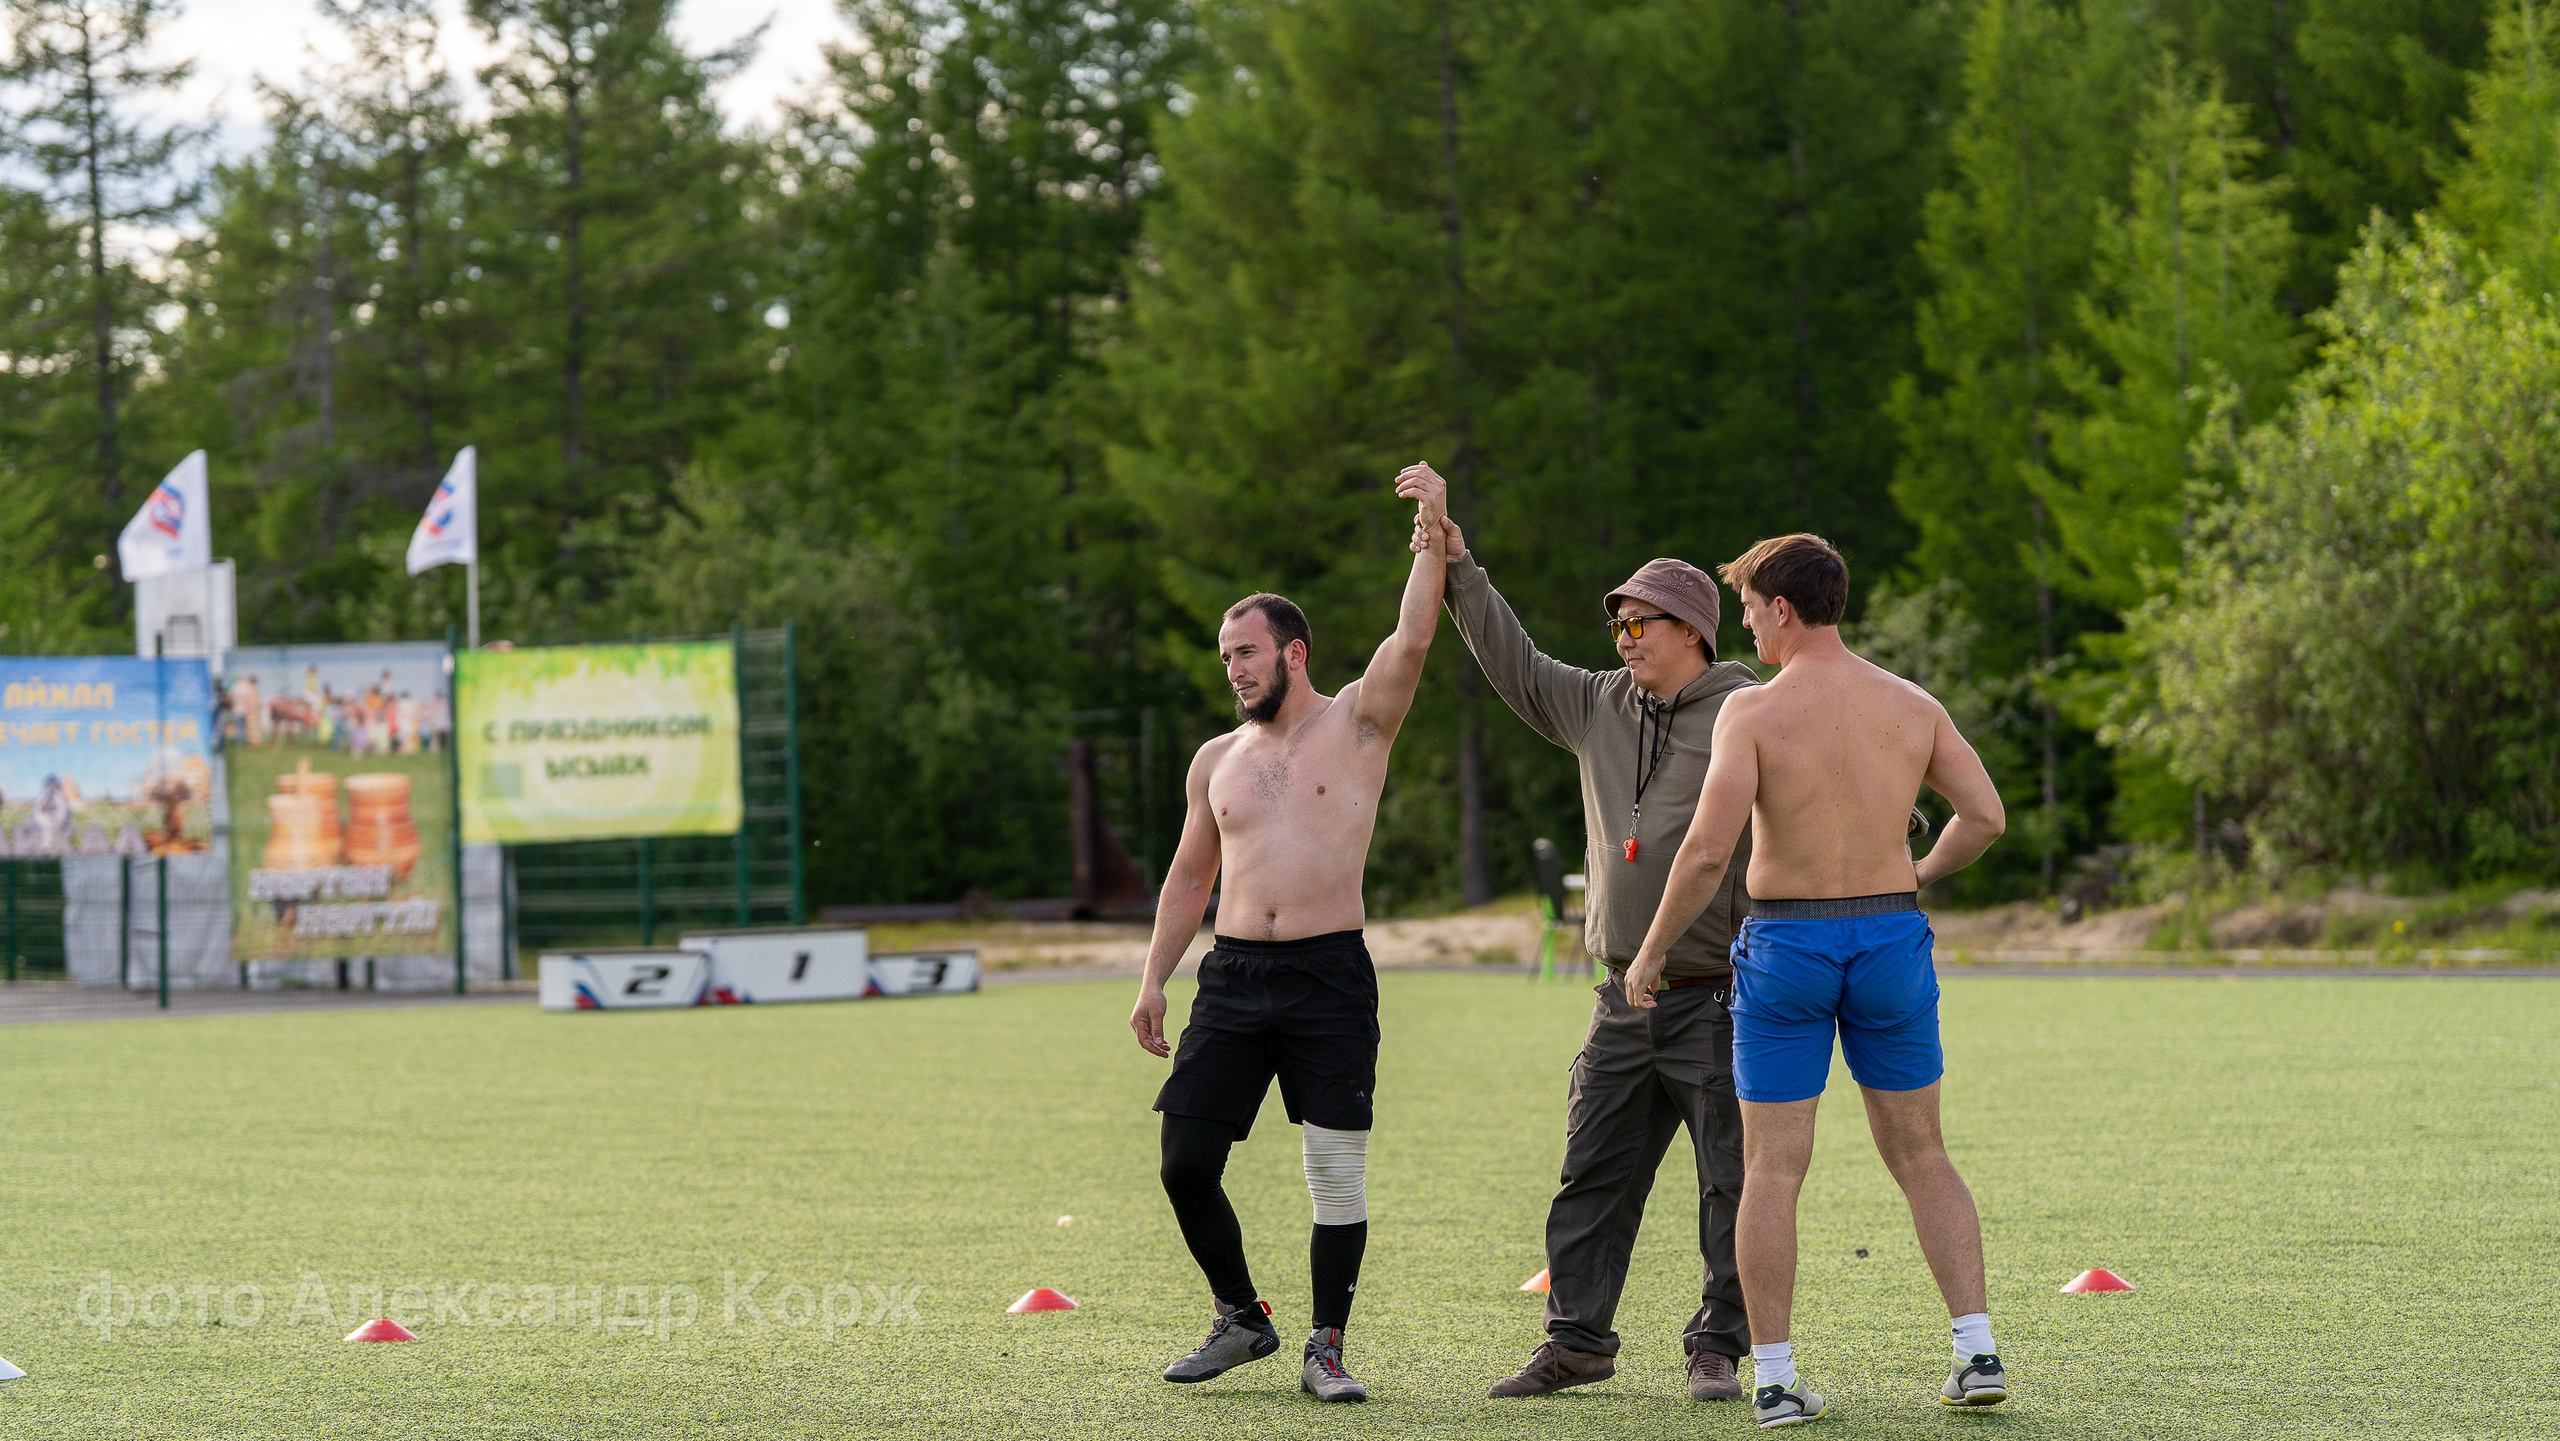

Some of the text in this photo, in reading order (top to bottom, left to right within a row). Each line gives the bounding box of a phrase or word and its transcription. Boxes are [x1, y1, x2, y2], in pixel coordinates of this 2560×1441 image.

[1665, 581, 1690, 597] adidas
[4, 676, 115, 709] АЙХАЛ
[90, 714, 199, 745] ГОСТЕЙ
[483, 716, 711, 743] С ПРАЗДНИКОМ
[624, 964, 670, 995] 2
[790, 951, 811, 981] 1
[909, 956, 950, 991] 3
